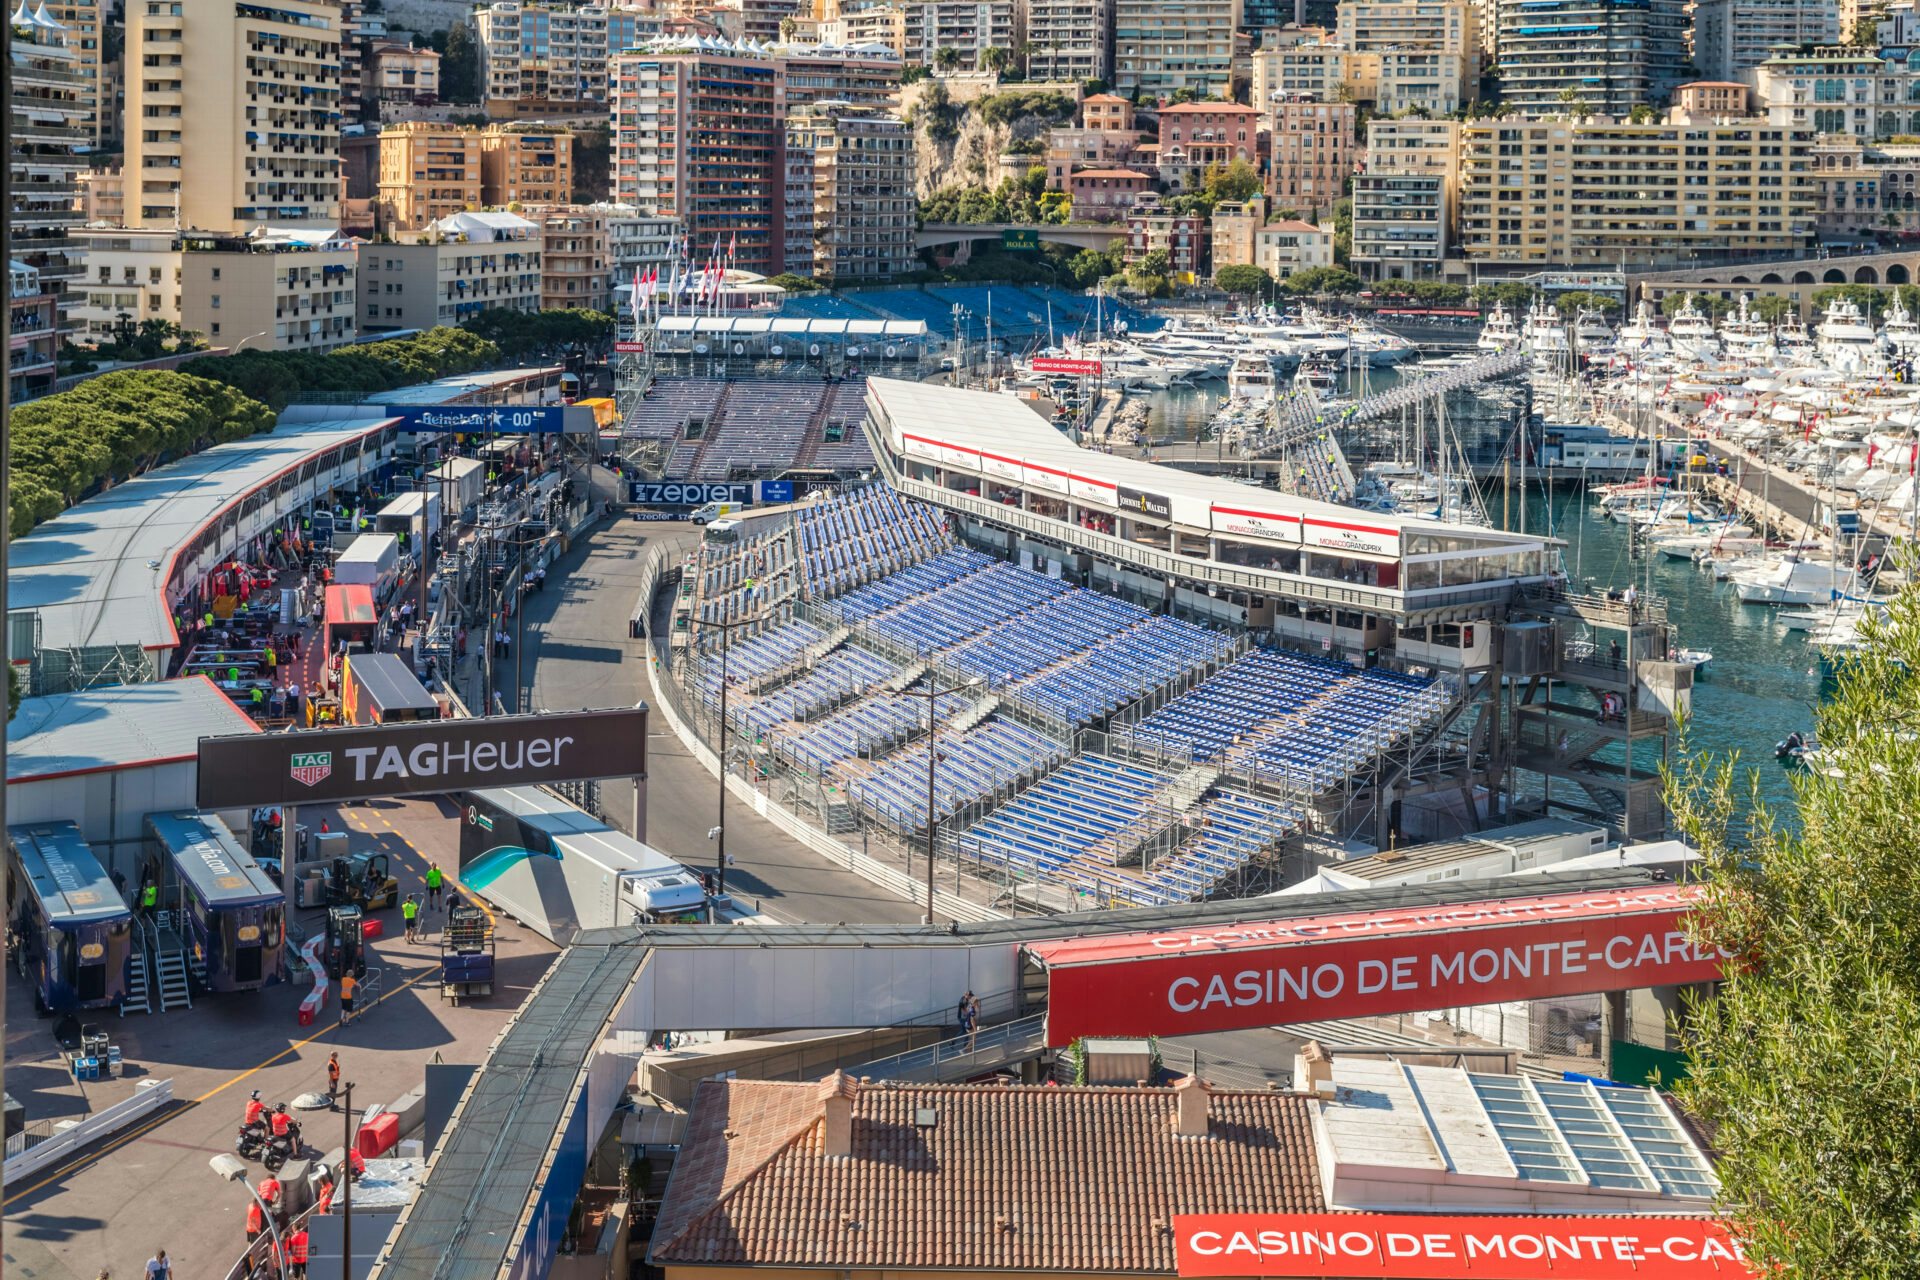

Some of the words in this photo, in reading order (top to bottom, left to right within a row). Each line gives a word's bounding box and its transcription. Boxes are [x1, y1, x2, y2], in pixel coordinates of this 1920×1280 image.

[647, 478, 746, 504] zepter
[1119, 494, 1141, 509] JOHNNIE
[1145, 500, 1168, 515] WALKER
[294, 754, 328, 766] TAG
[293, 767, 329, 784] HEUER
[184, 831, 230, 875] www.fia.com
[40, 845, 79, 891] www.fia.com
[1168, 963, 1345, 1013] CASINO
[1358, 956, 1418, 994] DE
[1189, 1231, 1374, 1257] CASINO
[1386, 1233, 1456, 1258] DE
